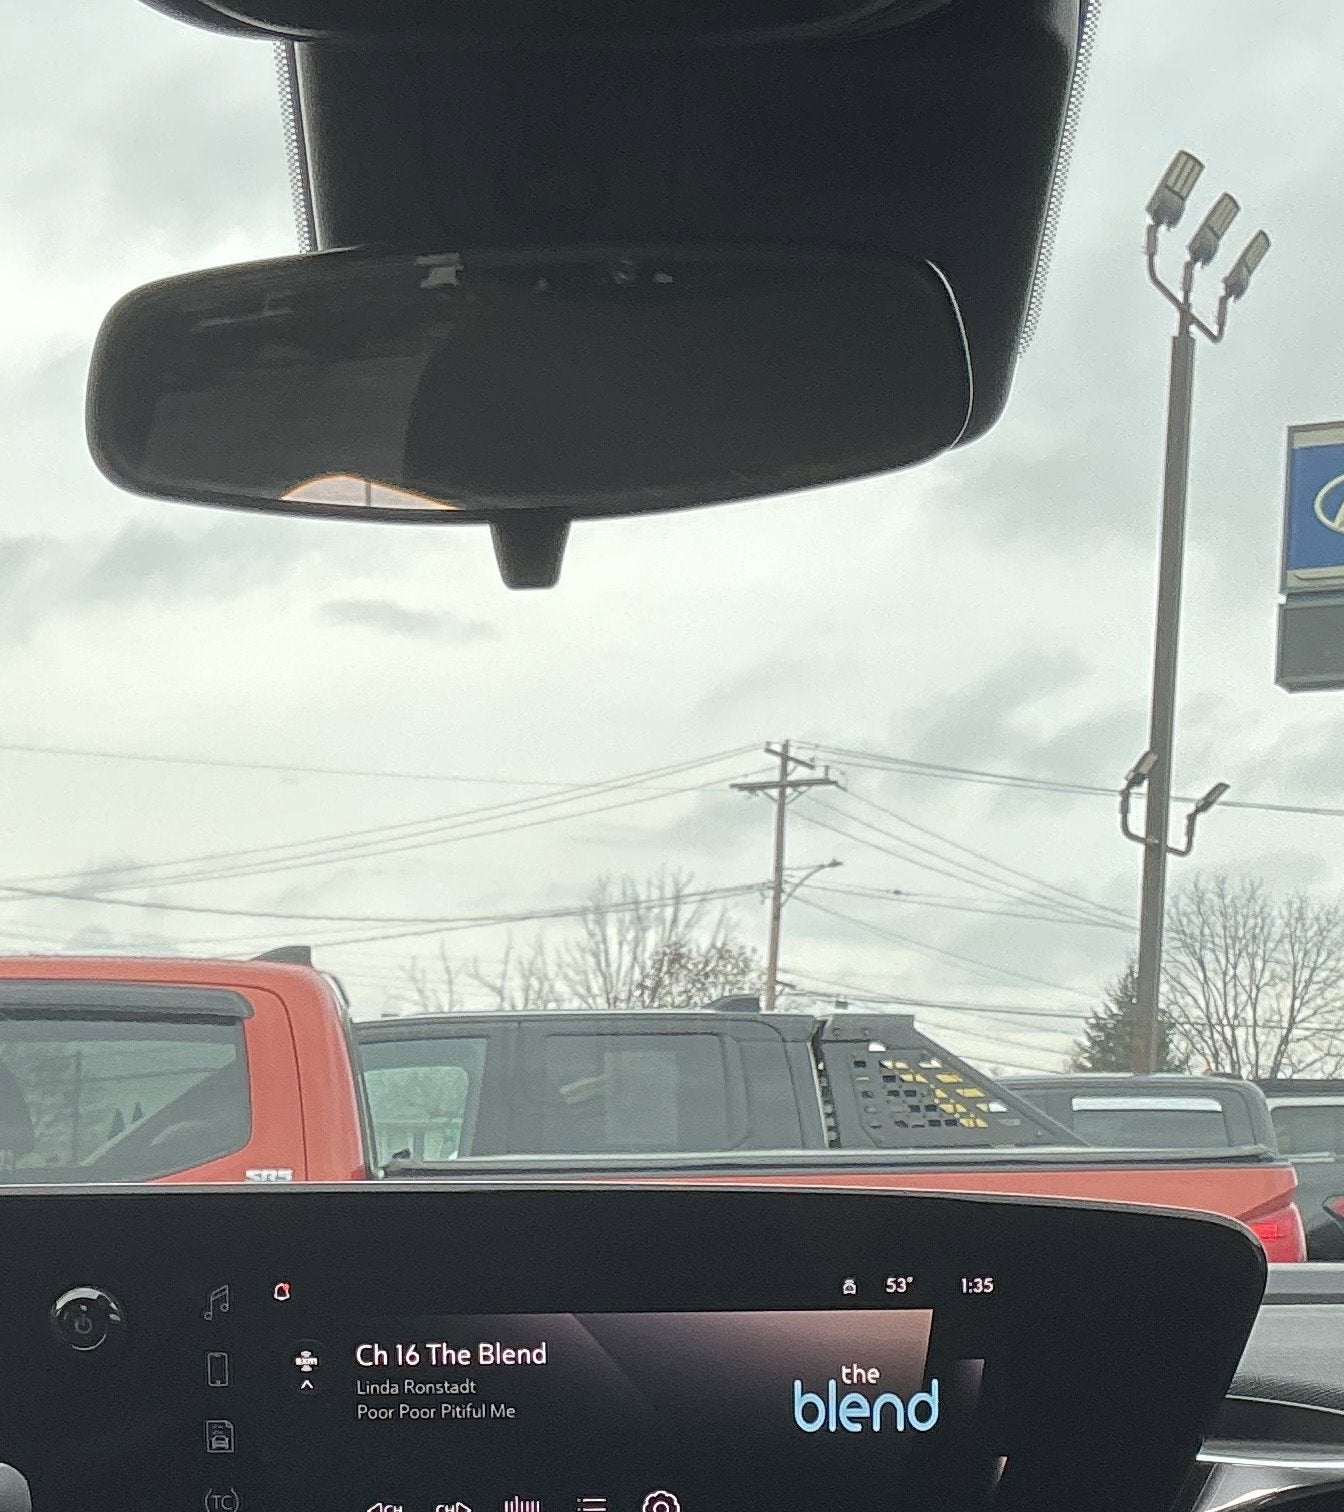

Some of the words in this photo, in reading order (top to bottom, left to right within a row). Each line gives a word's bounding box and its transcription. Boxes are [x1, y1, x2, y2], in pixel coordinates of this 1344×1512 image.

[961, 1277, 994, 1294] 1:35
[355, 1344, 389, 1367] Ch
[395, 1343, 420, 1367] 16
[425, 1343, 472, 1366] The
[478, 1341, 548, 1366] Blend
[841, 1363, 881, 1385] the
[355, 1378, 400, 1396] Linda
[403, 1377, 477, 1396] Ronstadt
[356, 1404, 395, 1421] Poor
[398, 1403, 437, 1421] Poor
[440, 1402, 487, 1420] Pitiful
[489, 1403, 517, 1420] Me
[792, 1378, 940, 1433] blend
